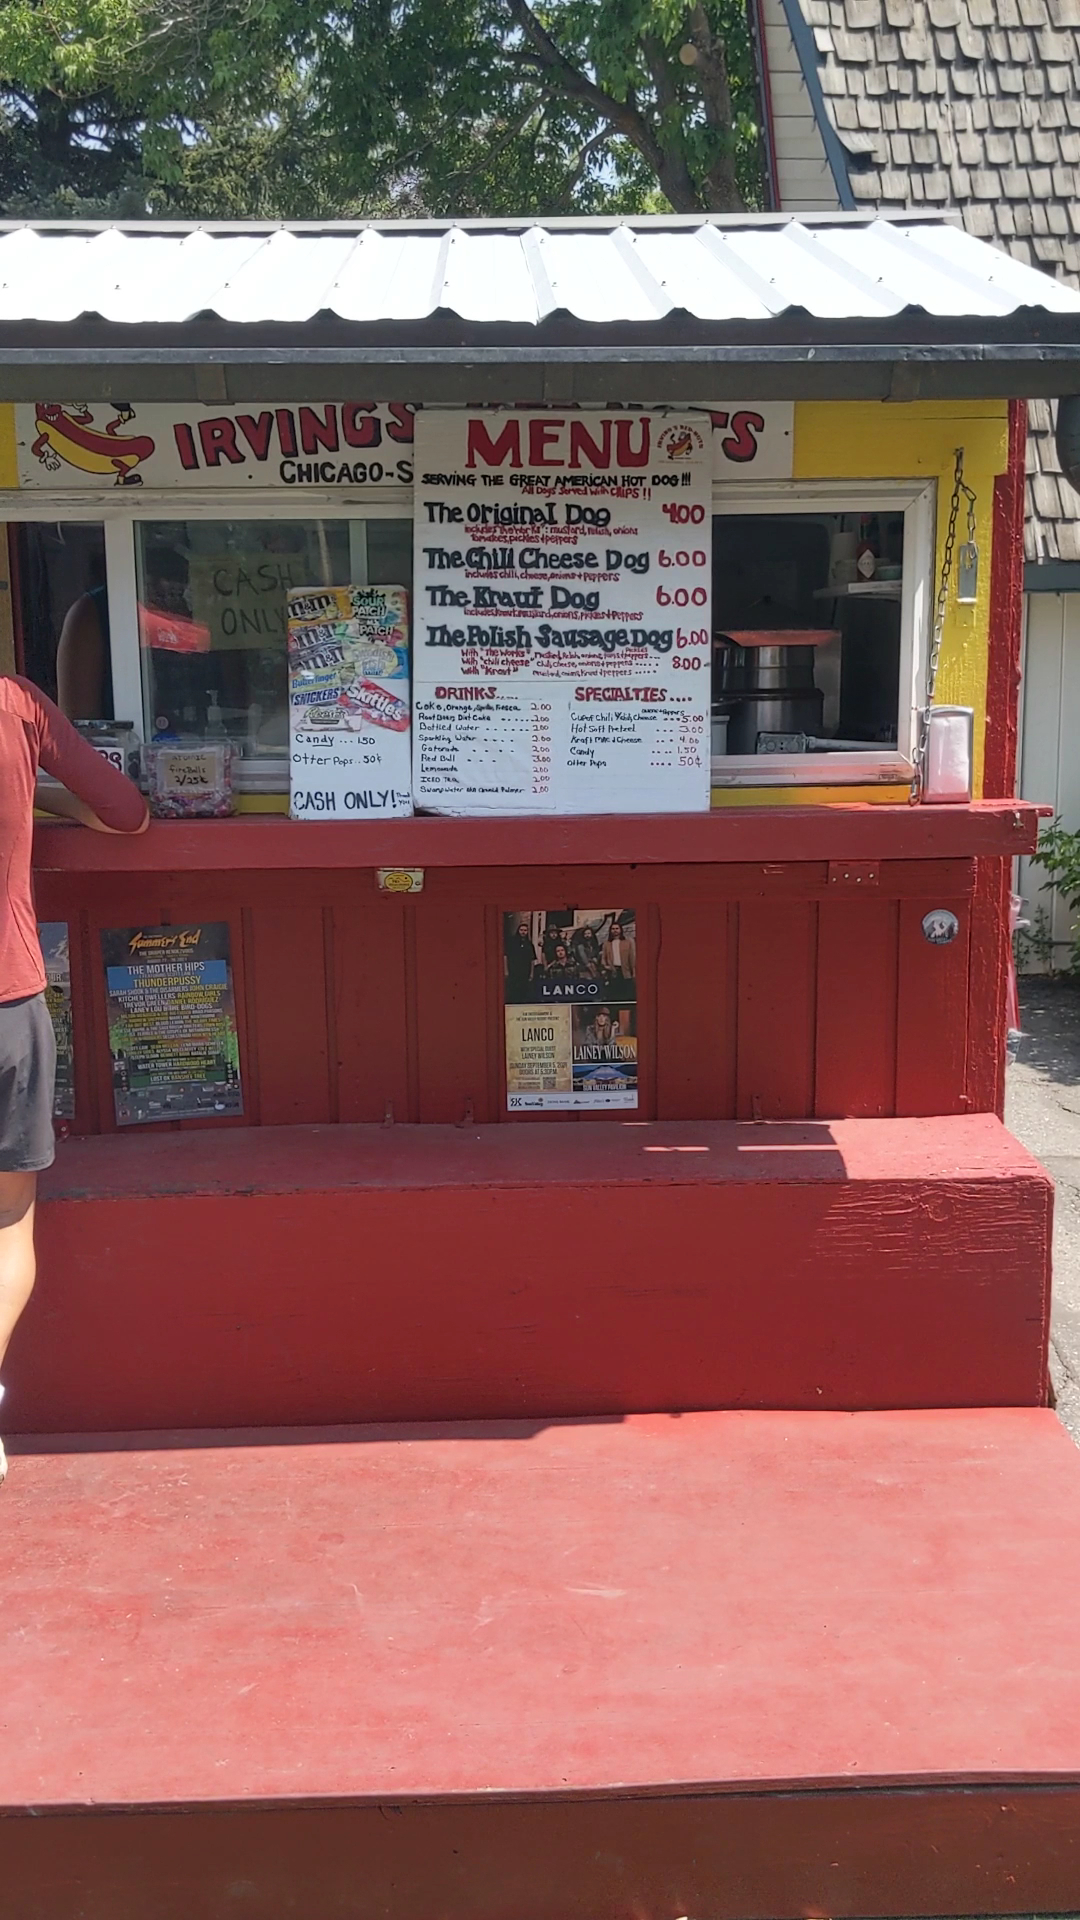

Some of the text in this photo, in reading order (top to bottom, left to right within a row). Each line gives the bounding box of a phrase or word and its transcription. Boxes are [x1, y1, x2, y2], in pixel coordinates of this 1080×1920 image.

[465, 417, 651, 469] MENU
[421, 471, 647, 487] SERVING THE GREAT AMERICAN HOT
[423, 502, 464, 523] The
[467, 502, 558, 525] Original
[565, 503, 611, 527] Dog
[423, 548, 465, 569] The
[519, 548, 599, 569] Cheese
[606, 549, 649, 574] Dog
[658, 549, 706, 568] 6.00
[213, 564, 295, 596] CASH
[352, 595, 386, 606] SOUR
[425, 585, 707, 611] The Kraut Dog 6.00
[352, 605, 387, 616] PATCH
[221, 606, 286, 635] ONLY
[359, 624, 394, 636] PATCH
[425, 624, 709, 653] The Polish Sausage Dog 6.00
[672, 655, 702, 671] 8.00
[293, 688, 340, 706] SNICKERS
[346, 684, 403, 721] Skittles
[681, 715, 704, 723] 5.00
[419, 722, 452, 731] Bottled
[455, 723, 480, 731] Water
[571, 723, 587, 733] Hot
[588, 725, 605, 733] Soft
[295, 734, 334, 747] Candy
[421, 754, 437, 762] Red
[439, 754, 456, 762] Bull
[569, 746, 697, 758] Candy 1.50
[292, 753, 331, 765] Otter
[333, 756, 353, 767] Pops
[293, 789, 397, 811] CASH ONLY!
[179, 929, 202, 948] End
[128, 965, 145, 975] THE
[146, 962, 183, 973] MOTHER
[184, 961, 205, 972] HIPS
[133, 975, 202, 988] THUNDERPUSSY
[543, 984, 598, 996] LANCO
[522, 1027, 554, 1041] LANCO
[573, 1045, 636, 1060] LAINEY WILSON
